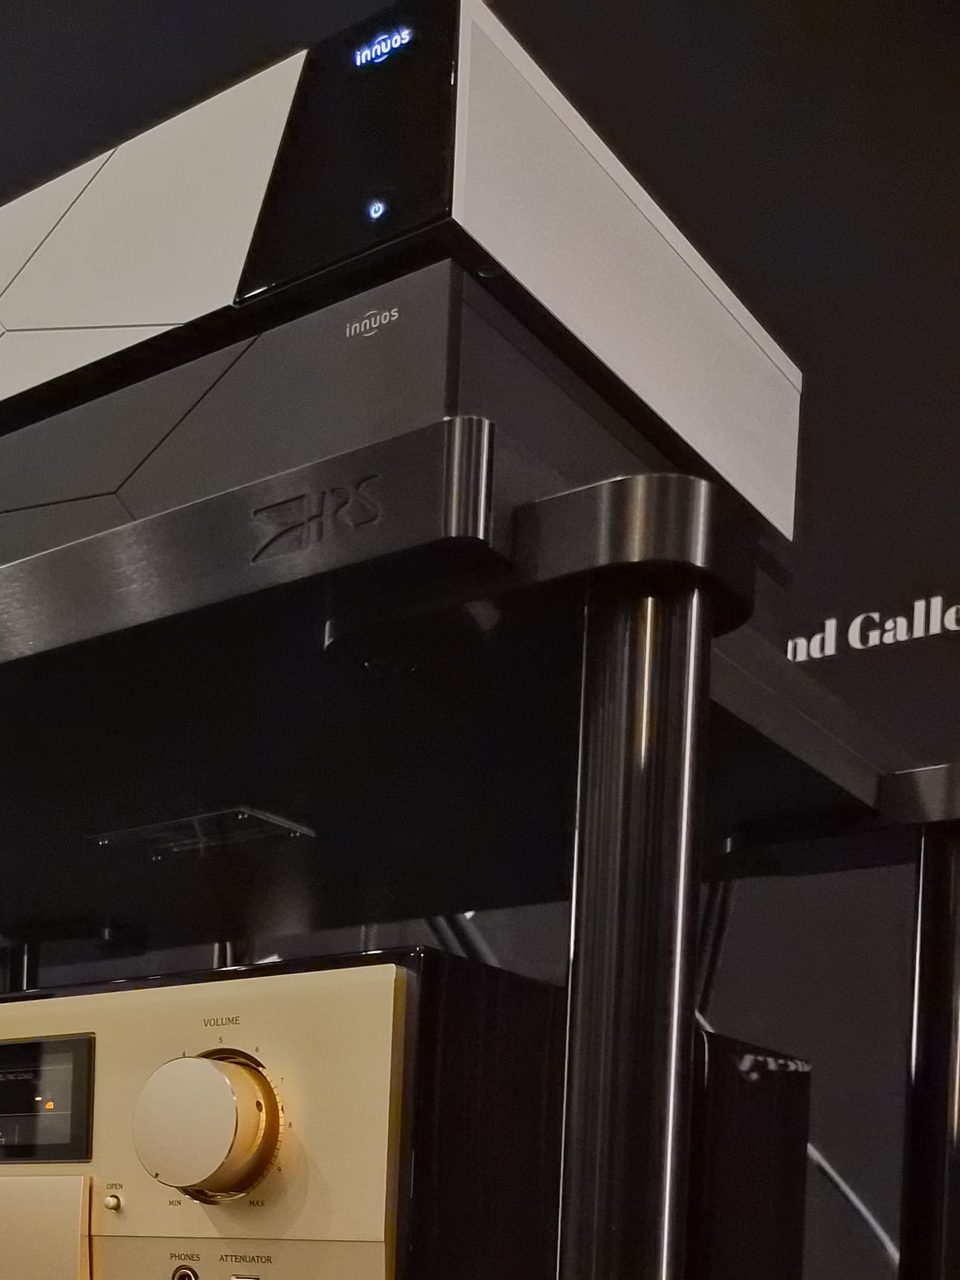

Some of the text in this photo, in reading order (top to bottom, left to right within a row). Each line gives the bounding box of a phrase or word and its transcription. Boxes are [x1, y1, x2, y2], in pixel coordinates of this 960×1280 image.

[354, 28, 412, 67] innuos
[345, 307, 400, 338] innuos
[847, 595, 960, 650] Galle
[203, 1016, 240, 1027] VOLUME
[169, 1252, 273, 1264] PHONES ATTENUATOR
